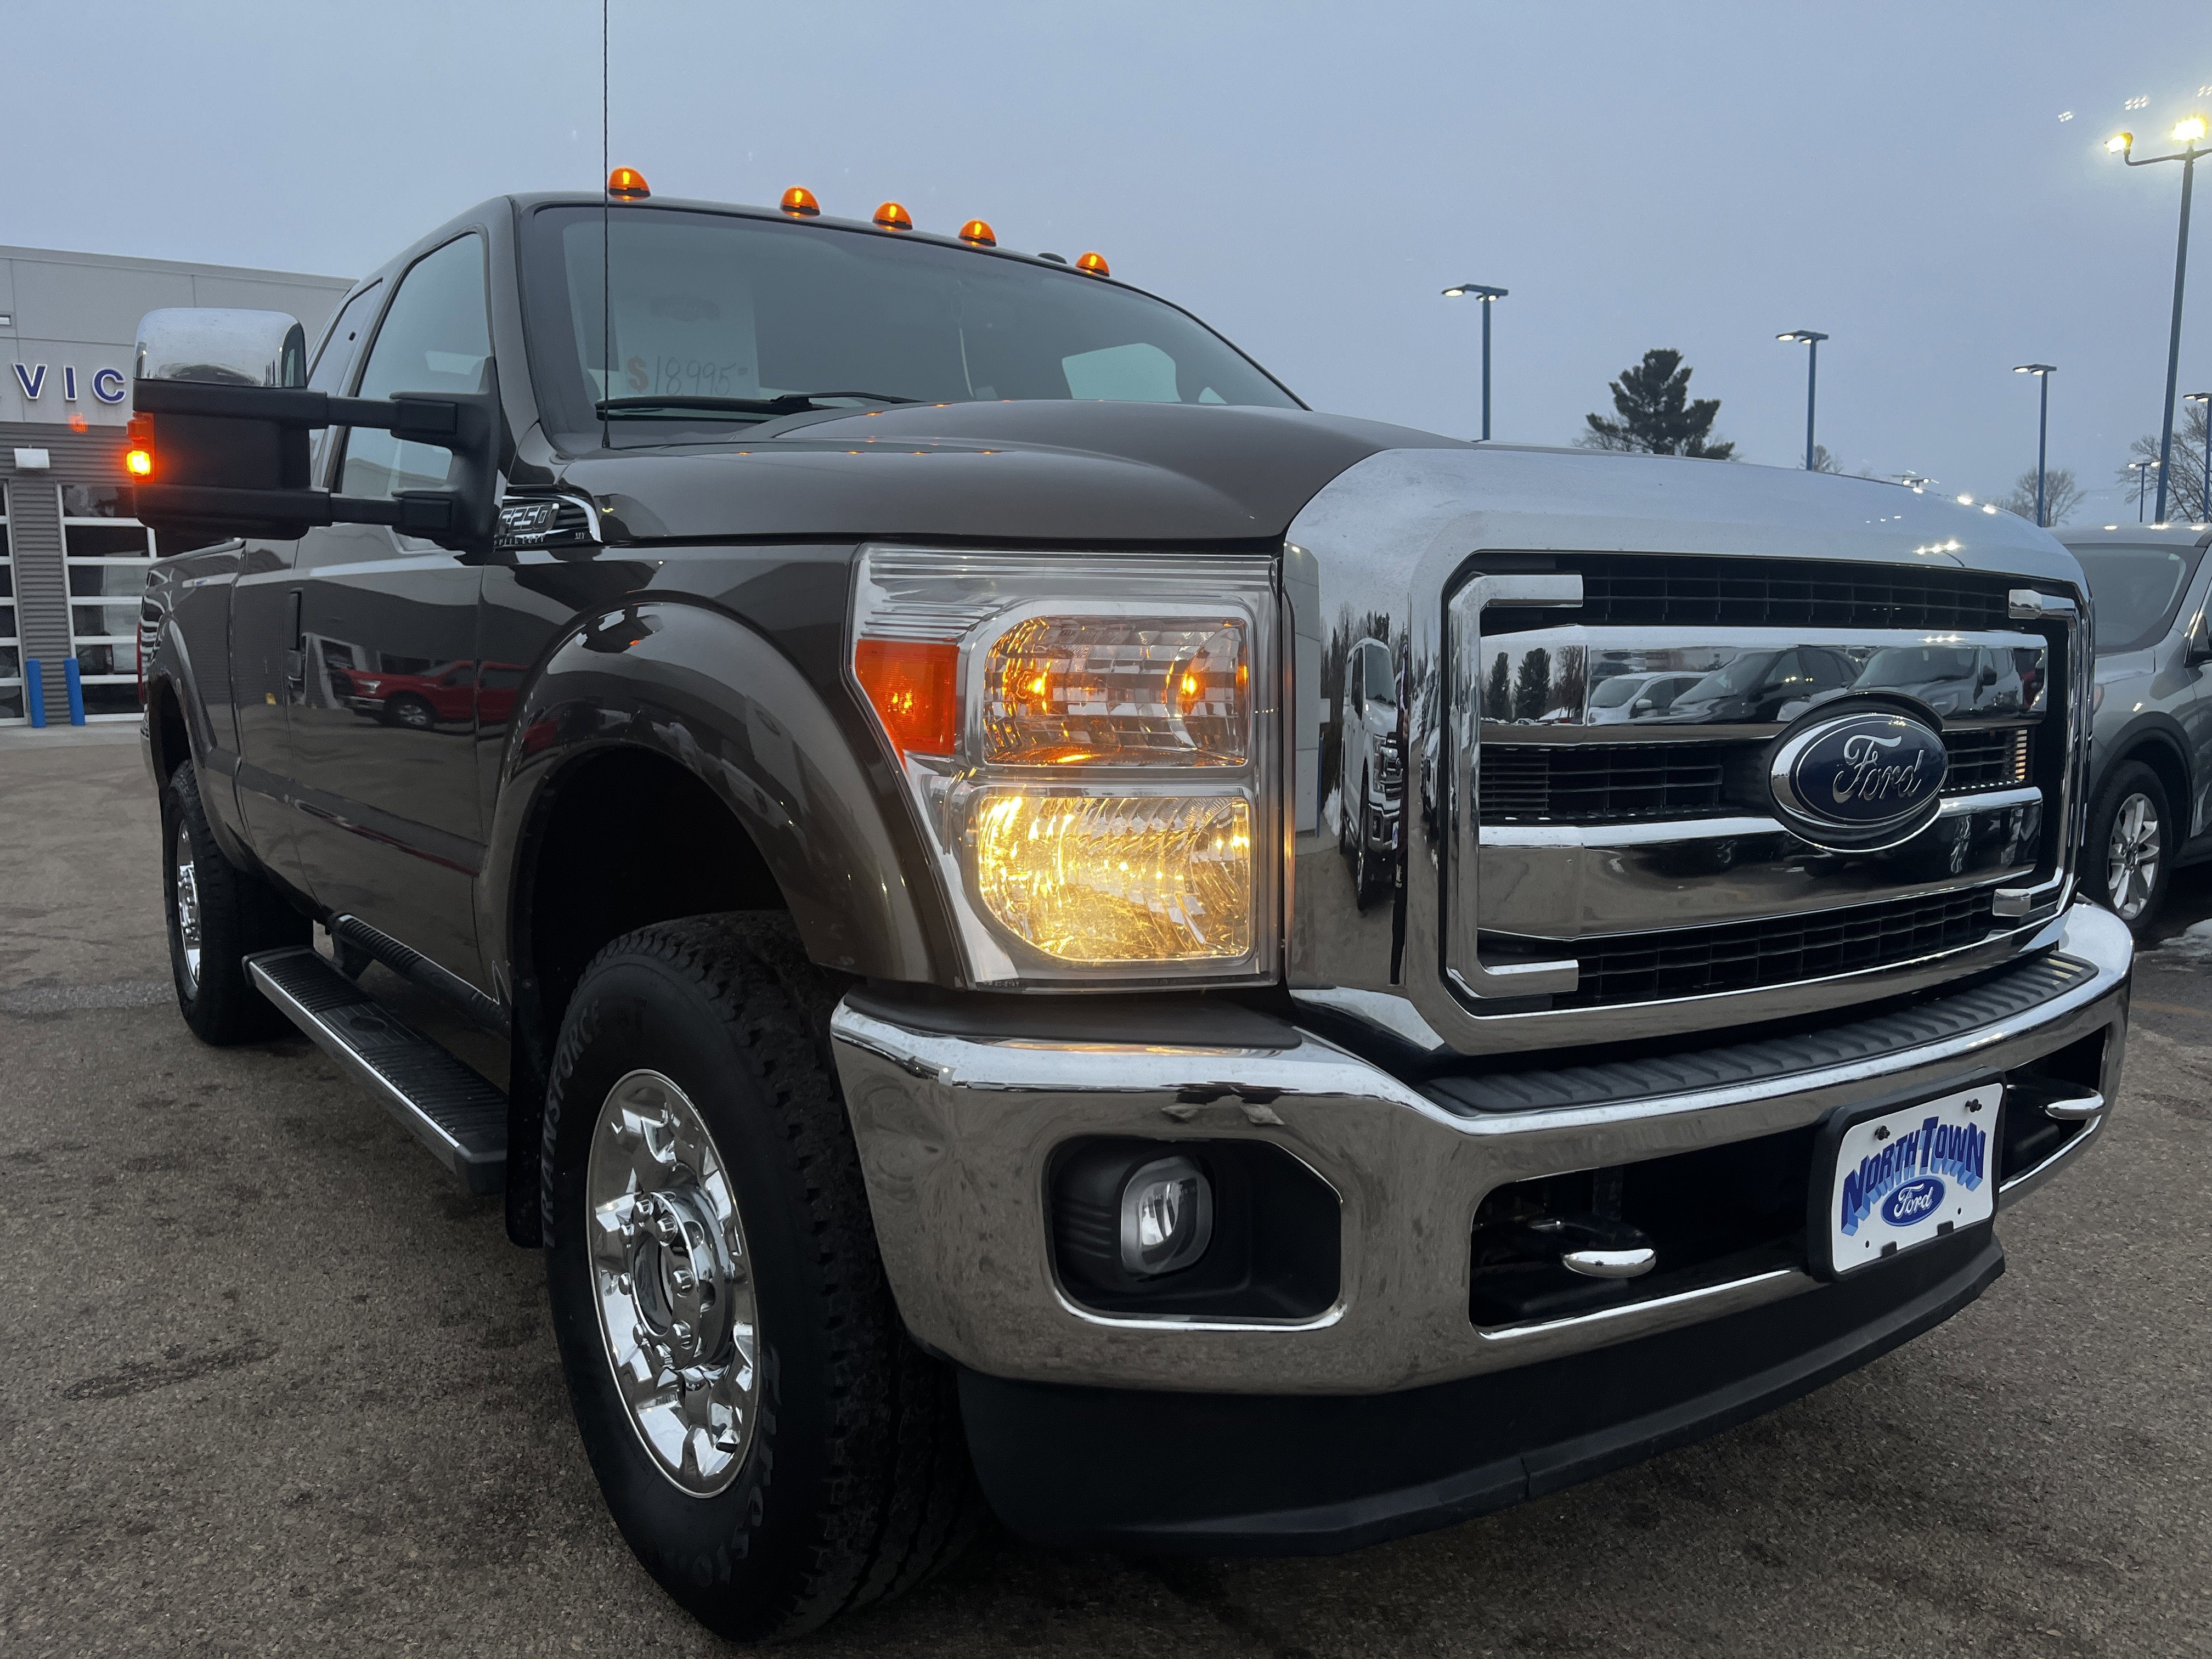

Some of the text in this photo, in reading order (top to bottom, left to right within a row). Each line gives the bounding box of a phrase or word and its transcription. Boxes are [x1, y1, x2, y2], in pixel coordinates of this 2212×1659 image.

[0, 362, 127, 404] VIC
[1832, 734, 1925, 804] Ford
[1893, 1182, 1934, 1219] Ford
